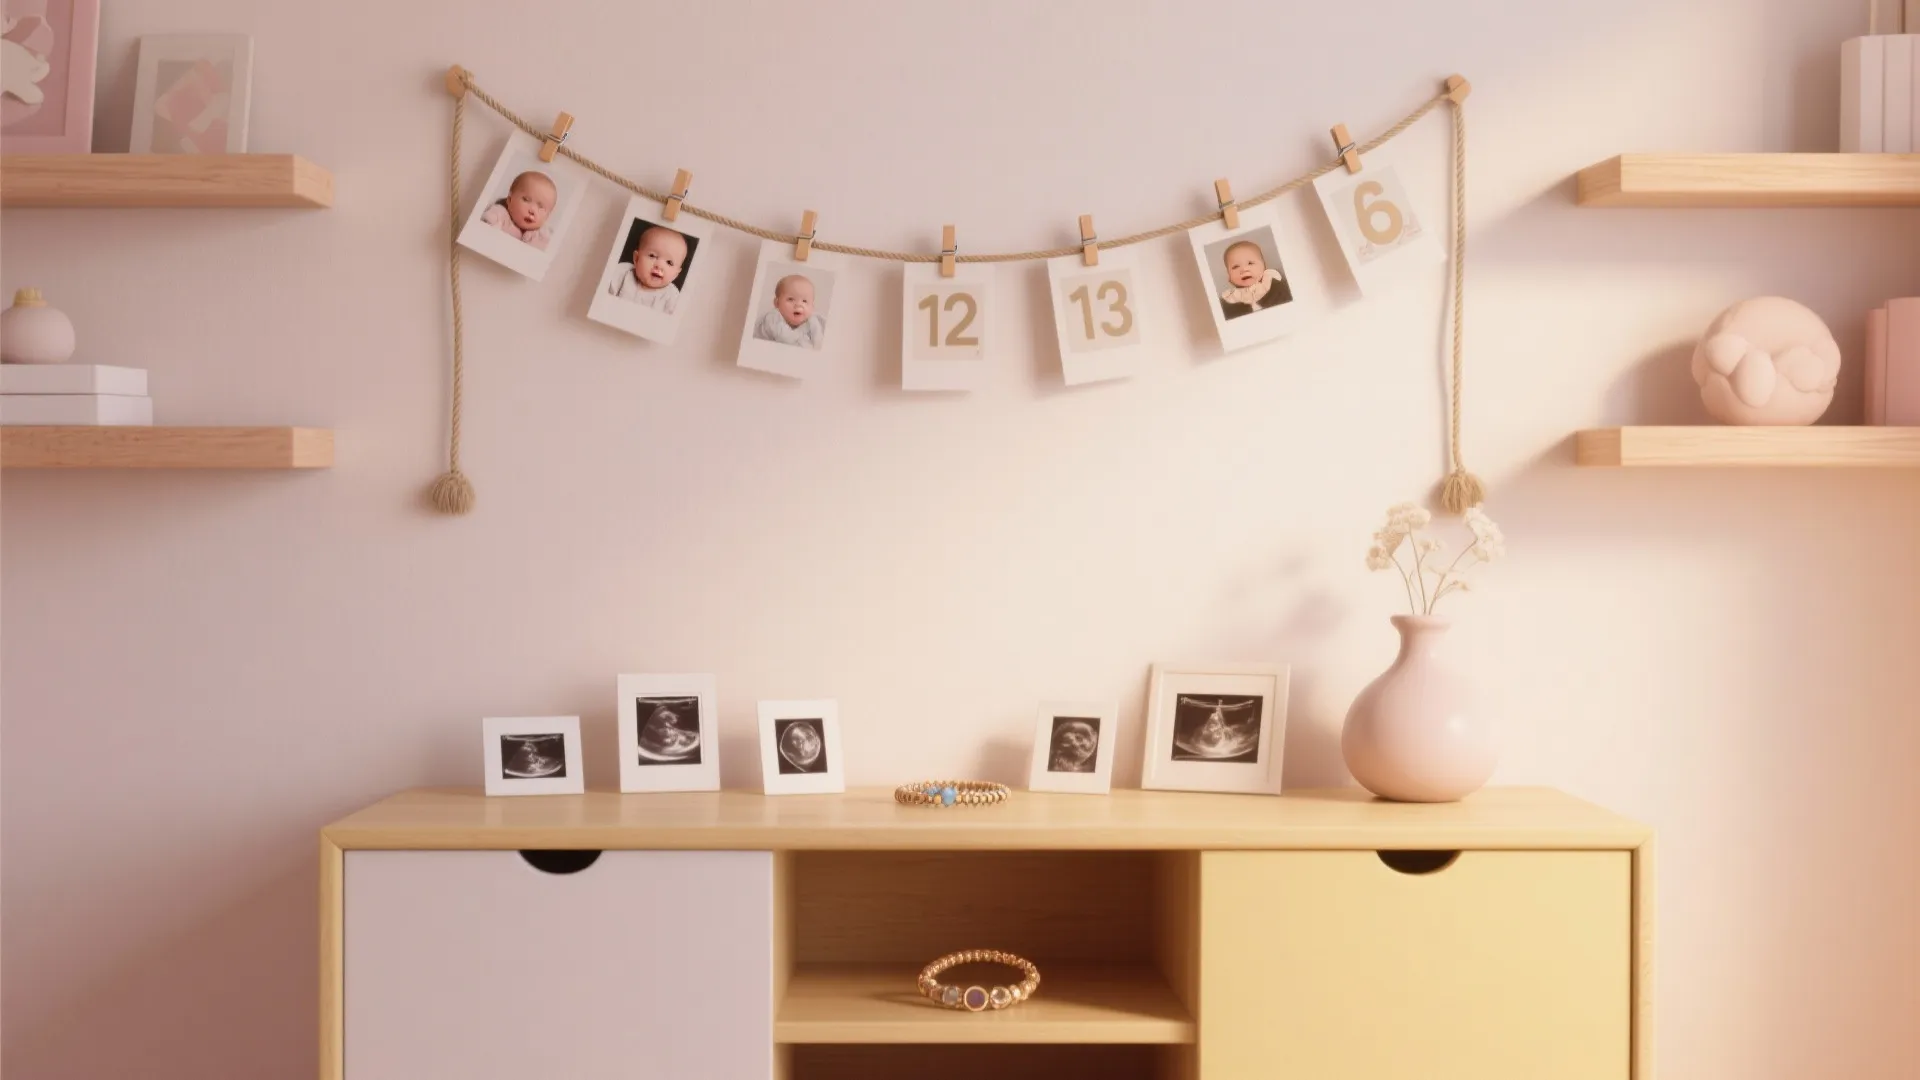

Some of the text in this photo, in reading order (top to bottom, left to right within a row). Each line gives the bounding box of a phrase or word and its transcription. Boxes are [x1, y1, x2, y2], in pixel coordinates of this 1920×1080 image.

[1354, 181, 1403, 245] 6
[918, 292, 979, 347] 12
[1069, 280, 1133, 340] 13
